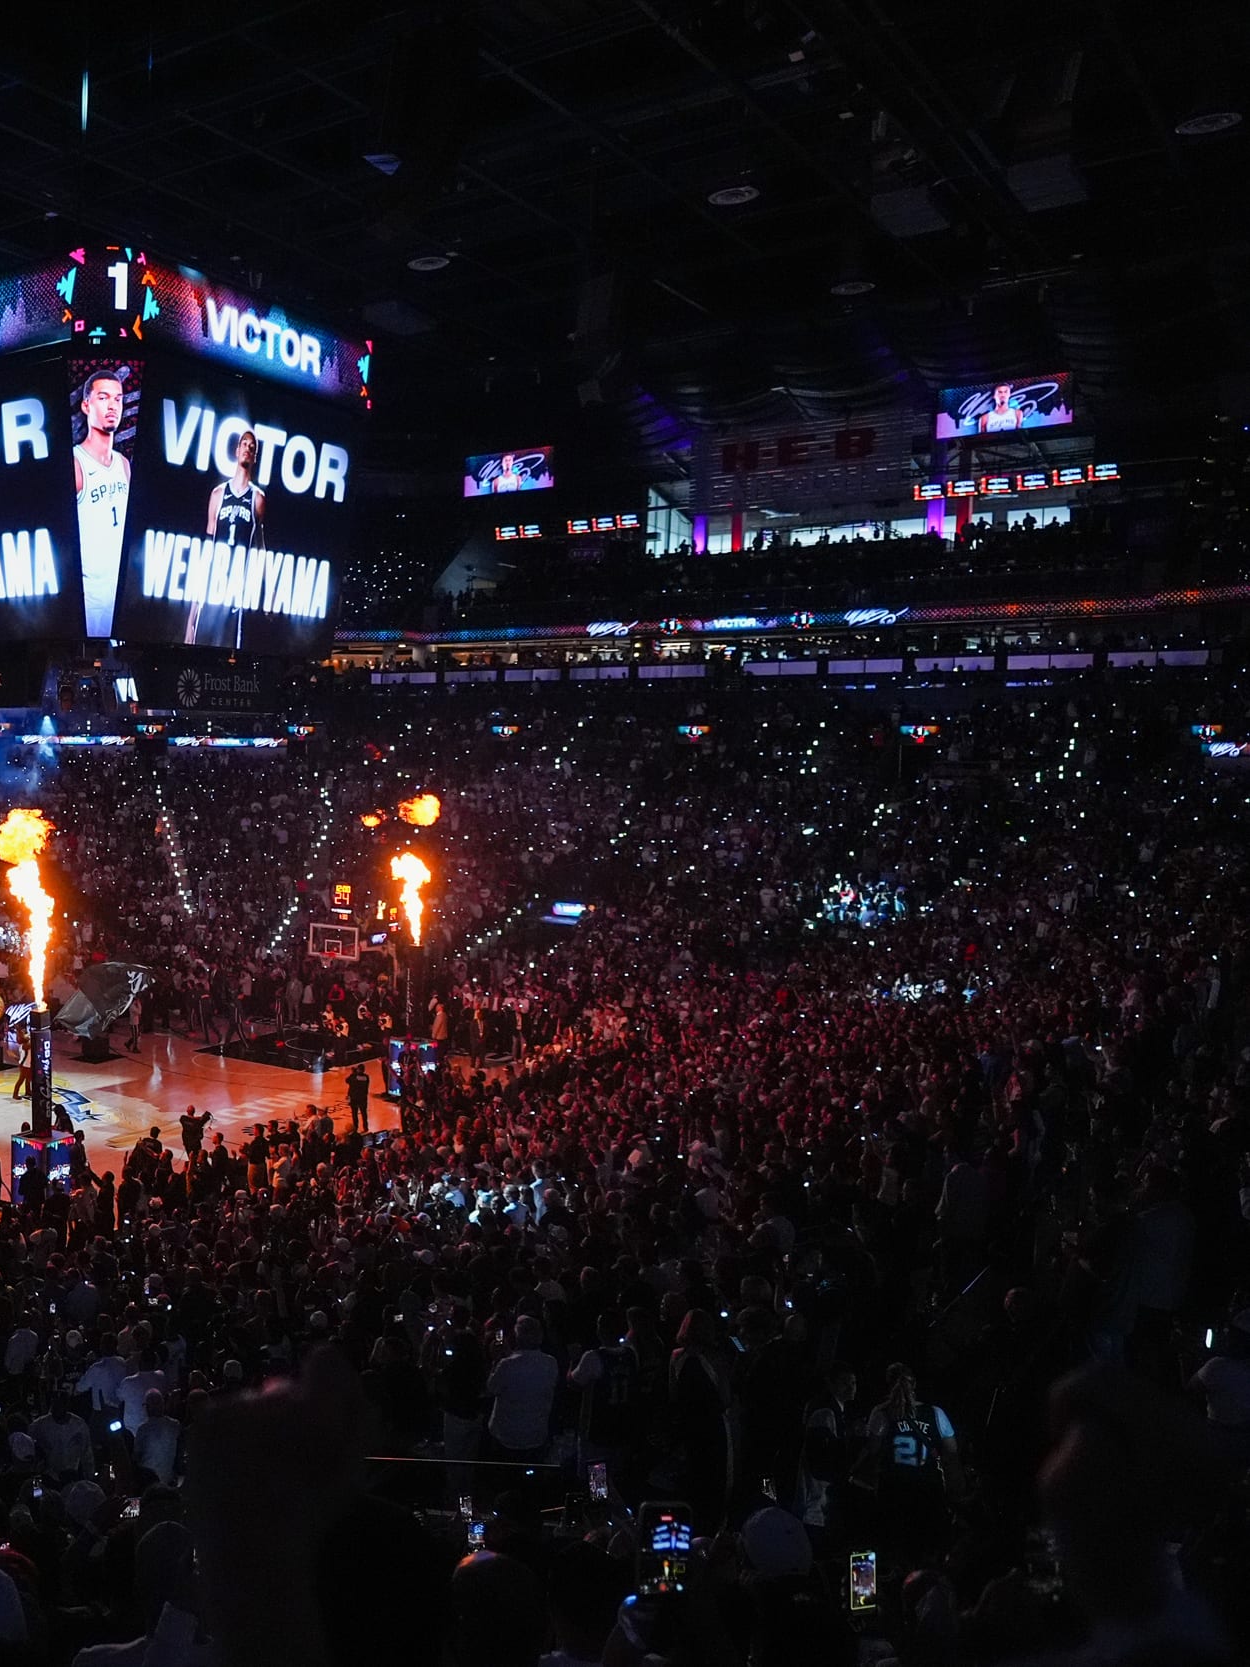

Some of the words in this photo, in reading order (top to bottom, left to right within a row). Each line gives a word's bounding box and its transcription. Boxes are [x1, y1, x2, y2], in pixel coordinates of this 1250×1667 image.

[107, 262, 128, 310] 1
[206, 298, 322, 376] VICTOR
[163, 398, 349, 503] VICTOR
[721, 427, 877, 473] H-E-B
[111, 506, 119, 528] 1
[227, 524, 237, 546] 1
[143, 529, 330, 618] WEMBANYAMA
[713, 617, 757, 629] VICTOR
[203, 672, 236, 692] Frost
[239, 671, 261, 694] Bank
[334, 892, 350, 905] 24
